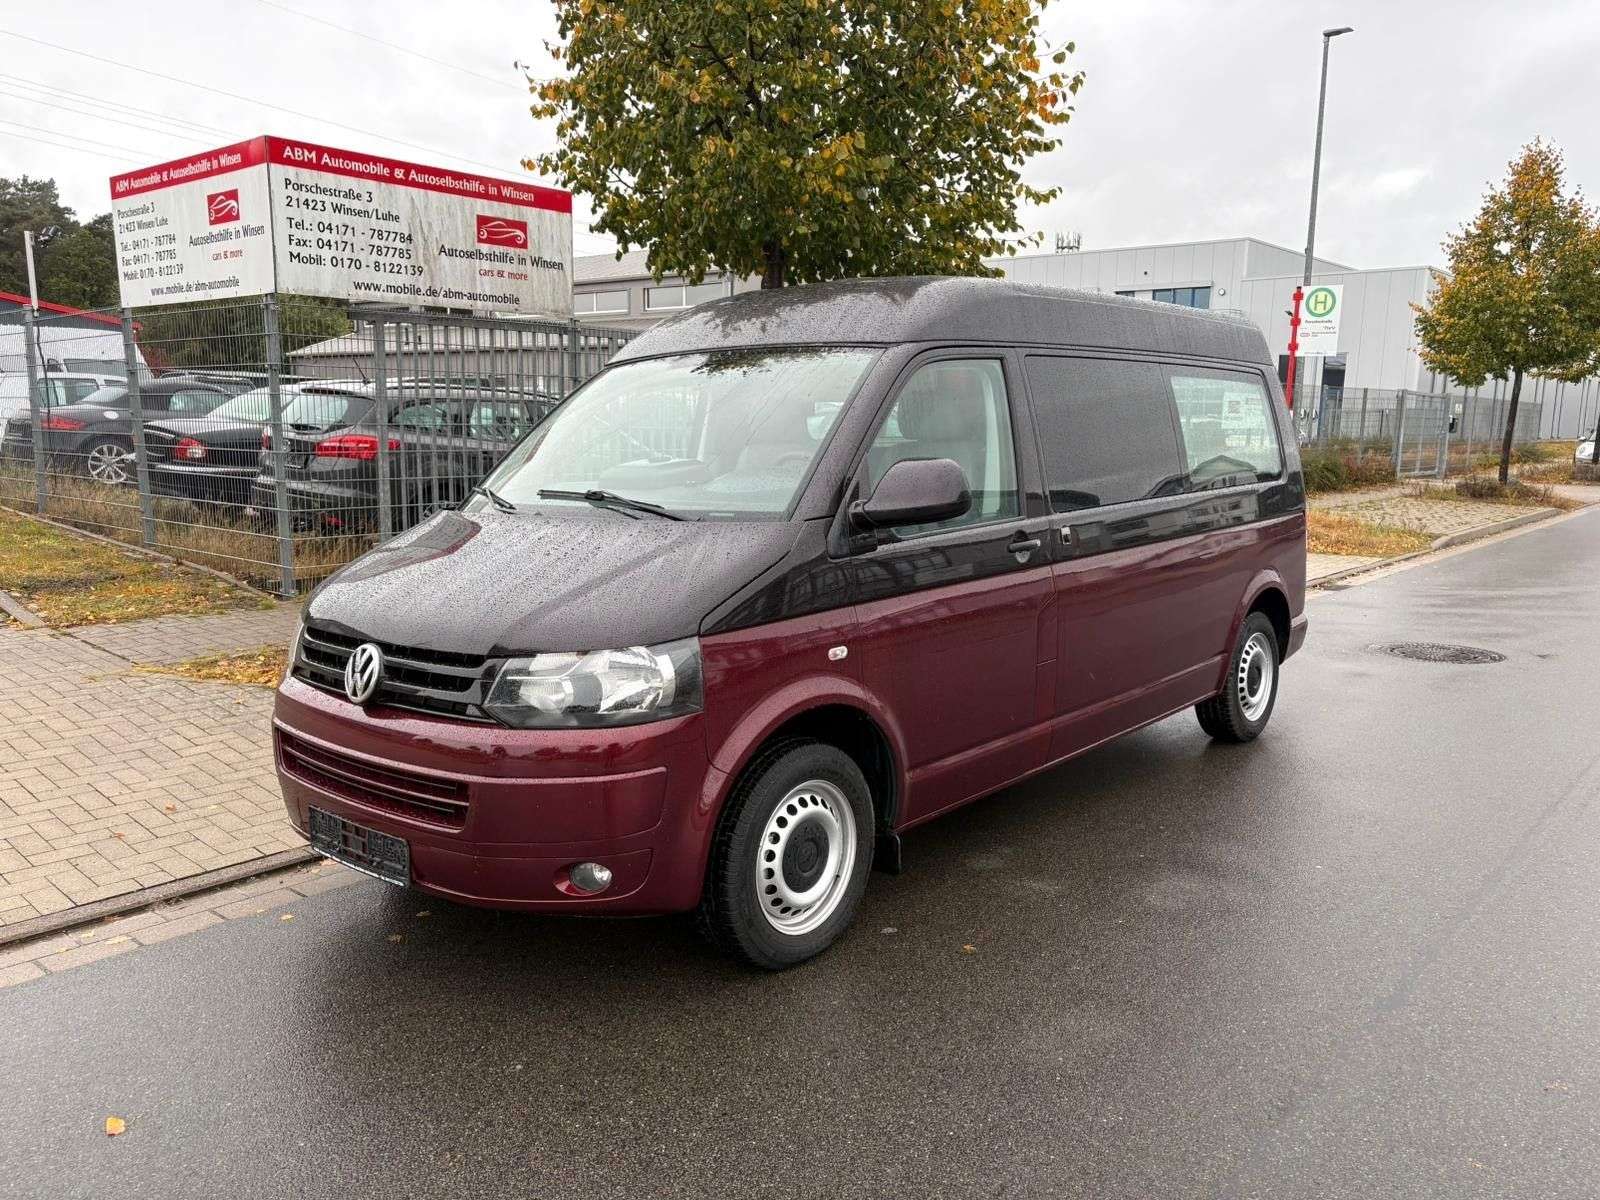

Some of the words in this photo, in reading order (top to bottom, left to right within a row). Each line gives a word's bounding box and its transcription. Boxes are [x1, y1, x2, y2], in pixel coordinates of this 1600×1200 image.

[115, 180, 130, 193] ABM
[131, 172, 161, 190] Automobile
[169, 158, 211, 180] Autoselbsthilfe
[212, 155, 218, 169] in
[219, 152, 241, 166] Winsen
[283, 145, 317, 164] ABM
[321, 154, 390, 178] Automobile
[394, 168, 405, 180] &
[409, 169, 485, 195] Autoselbsthilfe
[488, 183, 497, 196] in
[500, 184, 534, 202] Winsen
[284, 178, 362, 202] Porschestraße
[366, 191, 373, 203] 3
[285, 196, 327, 212] 21423
[331, 202, 400, 223] Winsen/Luhe
[189, 229, 233, 248] Autoselbsthilfe
[235, 227, 241, 240] in
[242, 224, 265, 238] Winsen
[286, 217, 313, 232] Tel.:
[317, 221, 356, 237] 04171
[369, 228, 413, 245] 787784
[132, 239, 149, 250] 04171
[288, 234, 312, 249] Fax:
[316, 238, 355, 254] 04171
[368, 244, 412, 260] 787785
[133, 253, 150, 265] 04171
[289, 251, 326, 268] Mobil:
[330, 256, 362, 270] 0170
[373, 262, 424, 278] 8122139
[438, 244, 515, 265] Autoselbsthilfe
[518, 254, 526, 267] in
[530, 255, 564, 272] Winsen
[140, 267, 154, 279] 0170
[478, 267, 495, 278] cars
[507, 271, 528, 281] more
[353, 280, 520, 304] www.mobile.de/abm-automobile
[1314, 294, 1328, 311] H
